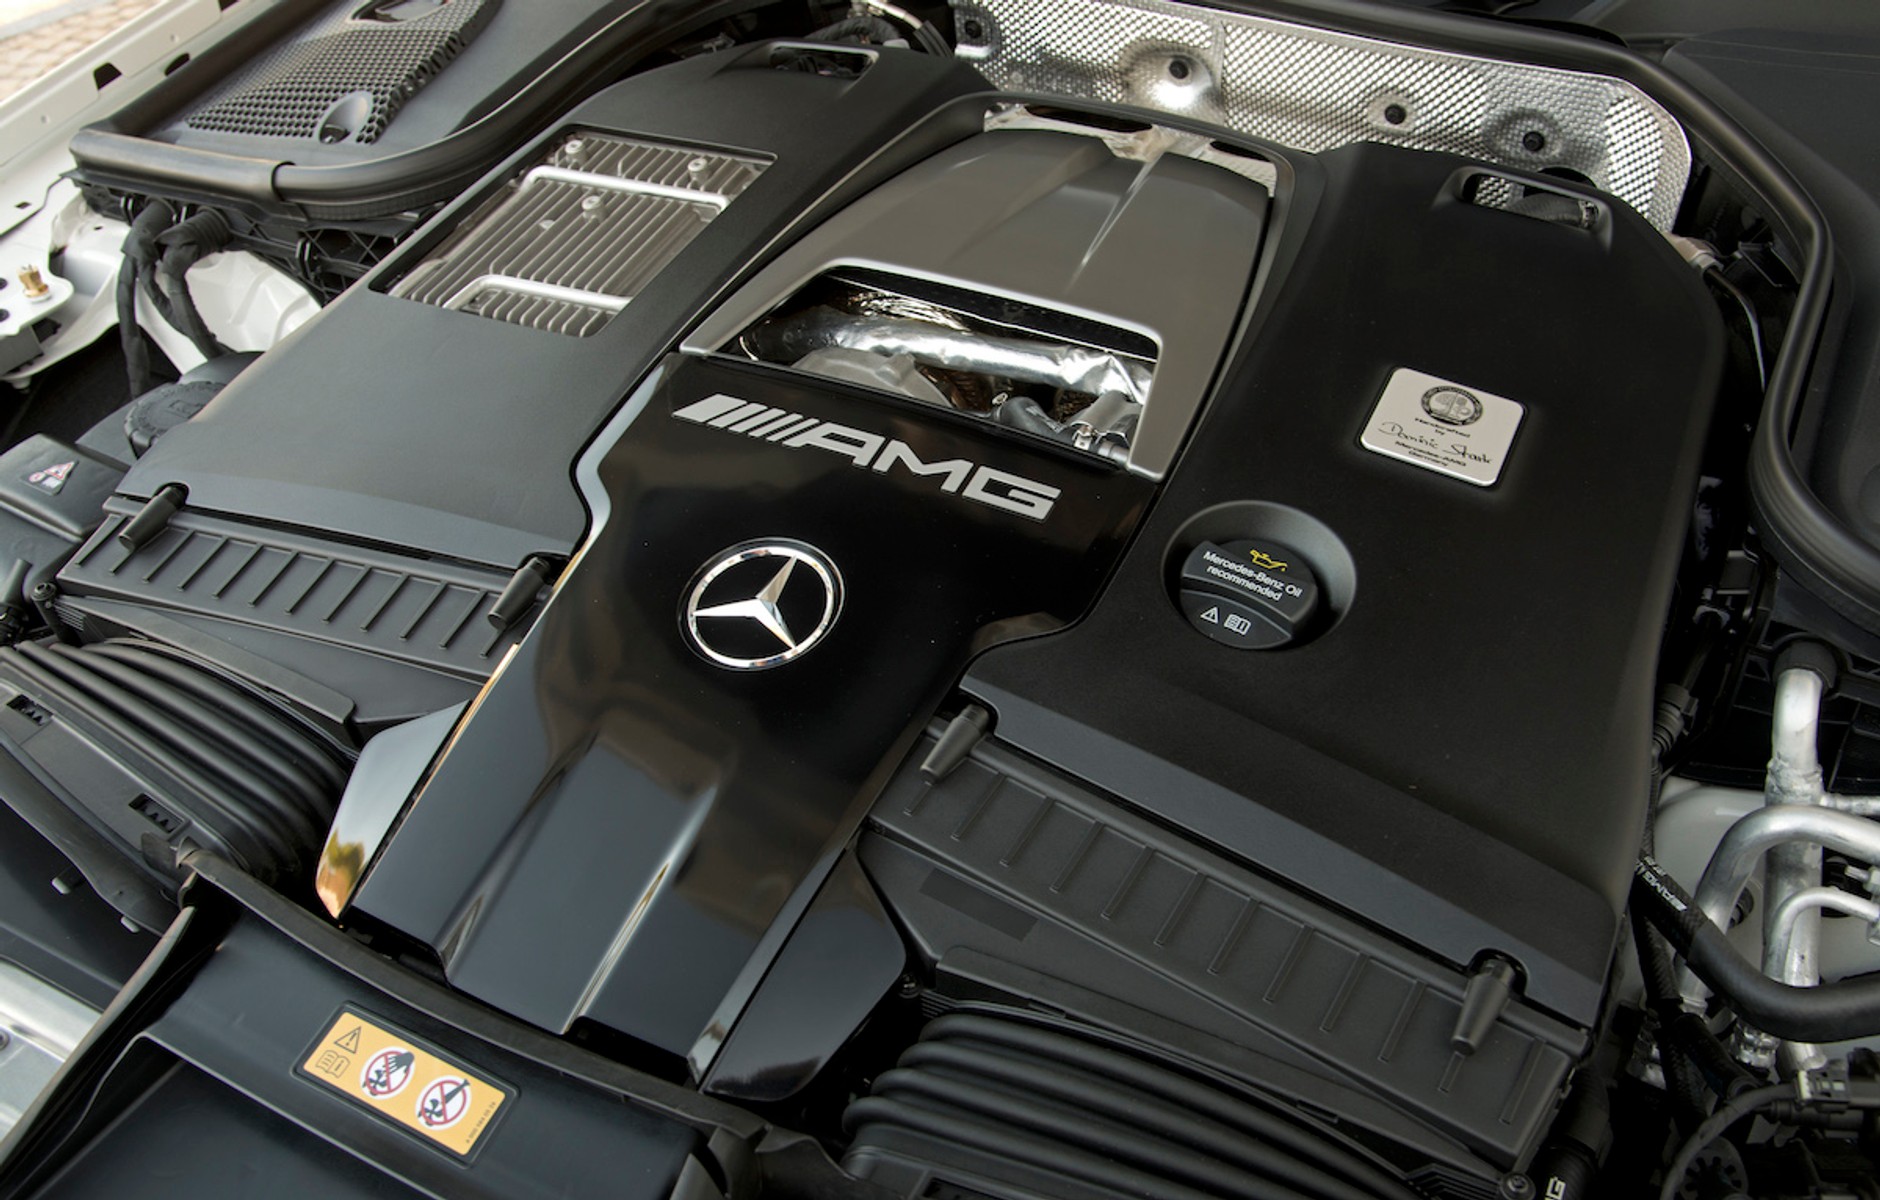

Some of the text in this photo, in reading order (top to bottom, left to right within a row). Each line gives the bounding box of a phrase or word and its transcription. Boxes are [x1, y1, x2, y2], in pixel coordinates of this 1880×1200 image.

[1378, 421, 1438, 449] Dominic
[1203, 551, 1303, 598] Mercedes-Benz Oil
[1206, 566, 1283, 601] recommended
